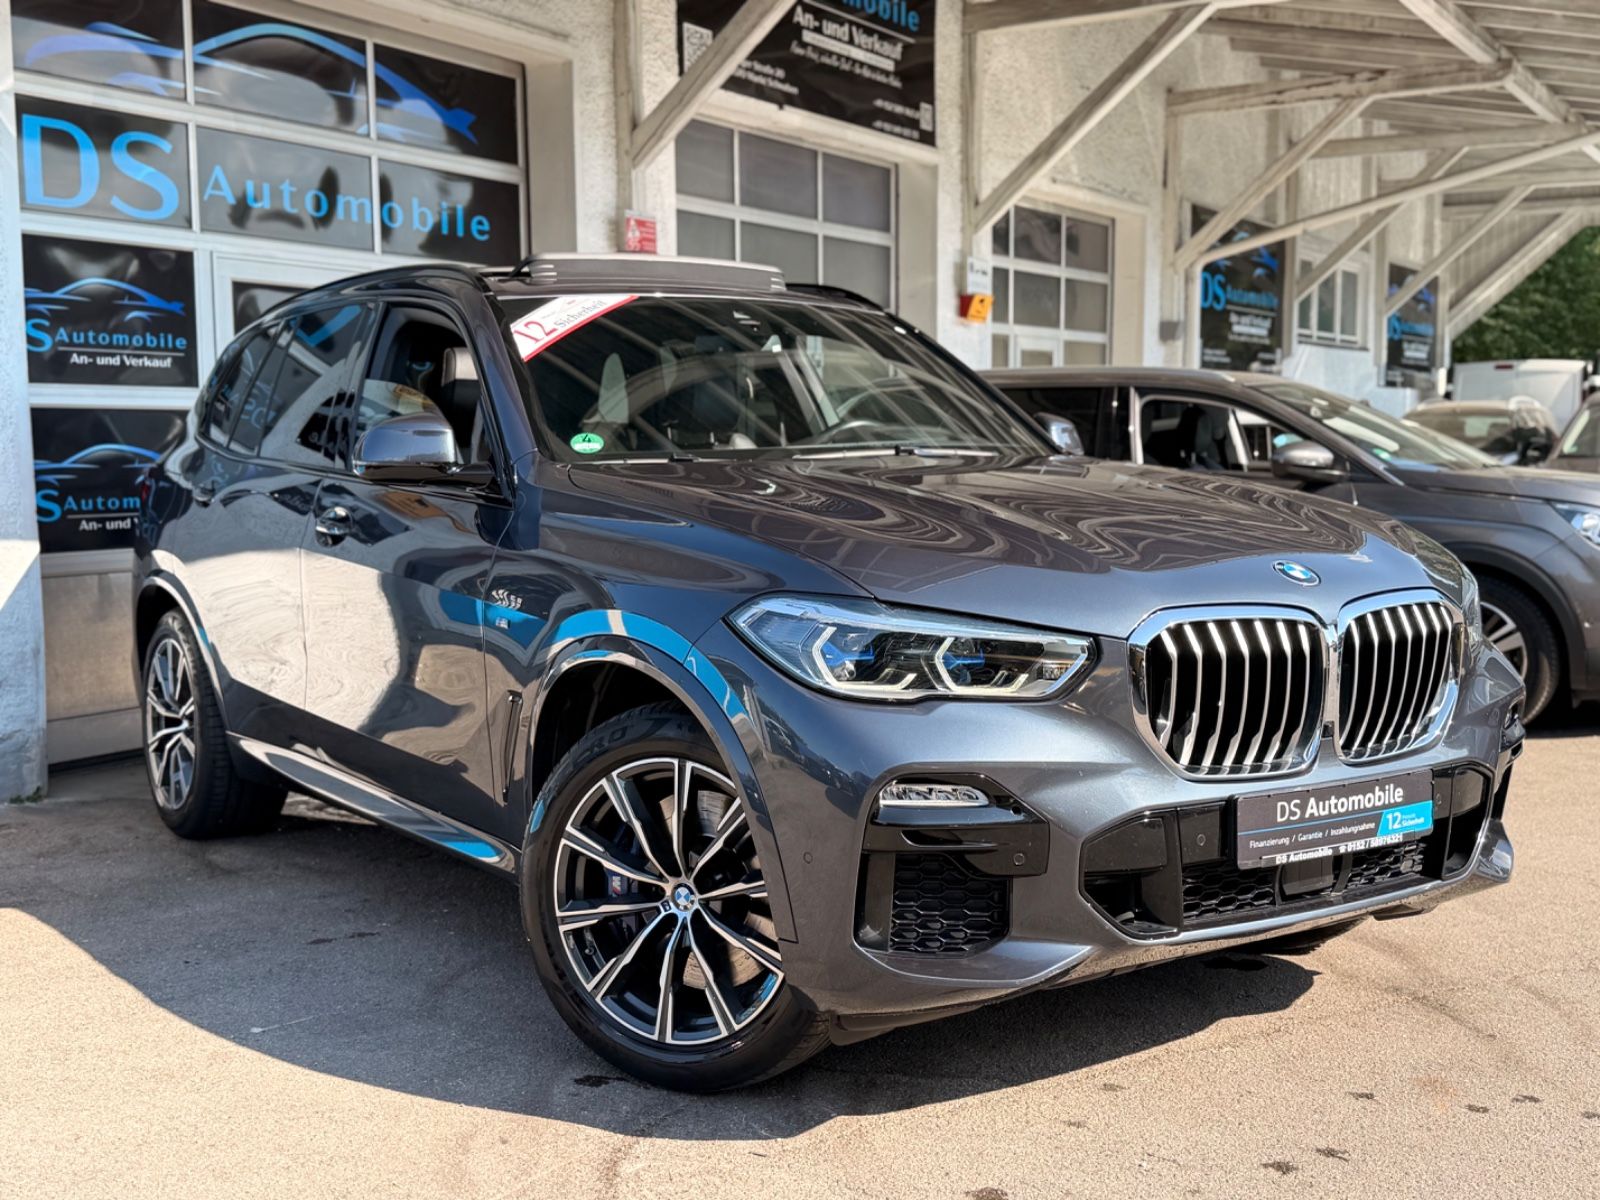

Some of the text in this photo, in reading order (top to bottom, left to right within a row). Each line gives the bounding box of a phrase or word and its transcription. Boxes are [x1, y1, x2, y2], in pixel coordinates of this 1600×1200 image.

[822, 19, 850, 42] und
[851, 25, 904, 61] Verkauf
[21, 114, 491, 241] DS Automobile
[513, 299, 608, 344] 12 Sicherheit
[55, 326, 188, 350] Automobile
[69, 352, 173, 368] An- und Verkauf
[64, 495, 141, 512] Autom
[79, 520, 103, 532] An-
[105, 517, 132, 530] und
[1276, 783, 1405, 822] DS Automobile
[1386, 812, 1403, 831] 12
[1249, 836, 1291, 849] Finanzierung
[1297, 830, 1324, 842] Garantie
[1275, 855, 1288, 865] DS
[1288, 847, 1334, 862] Automobile
